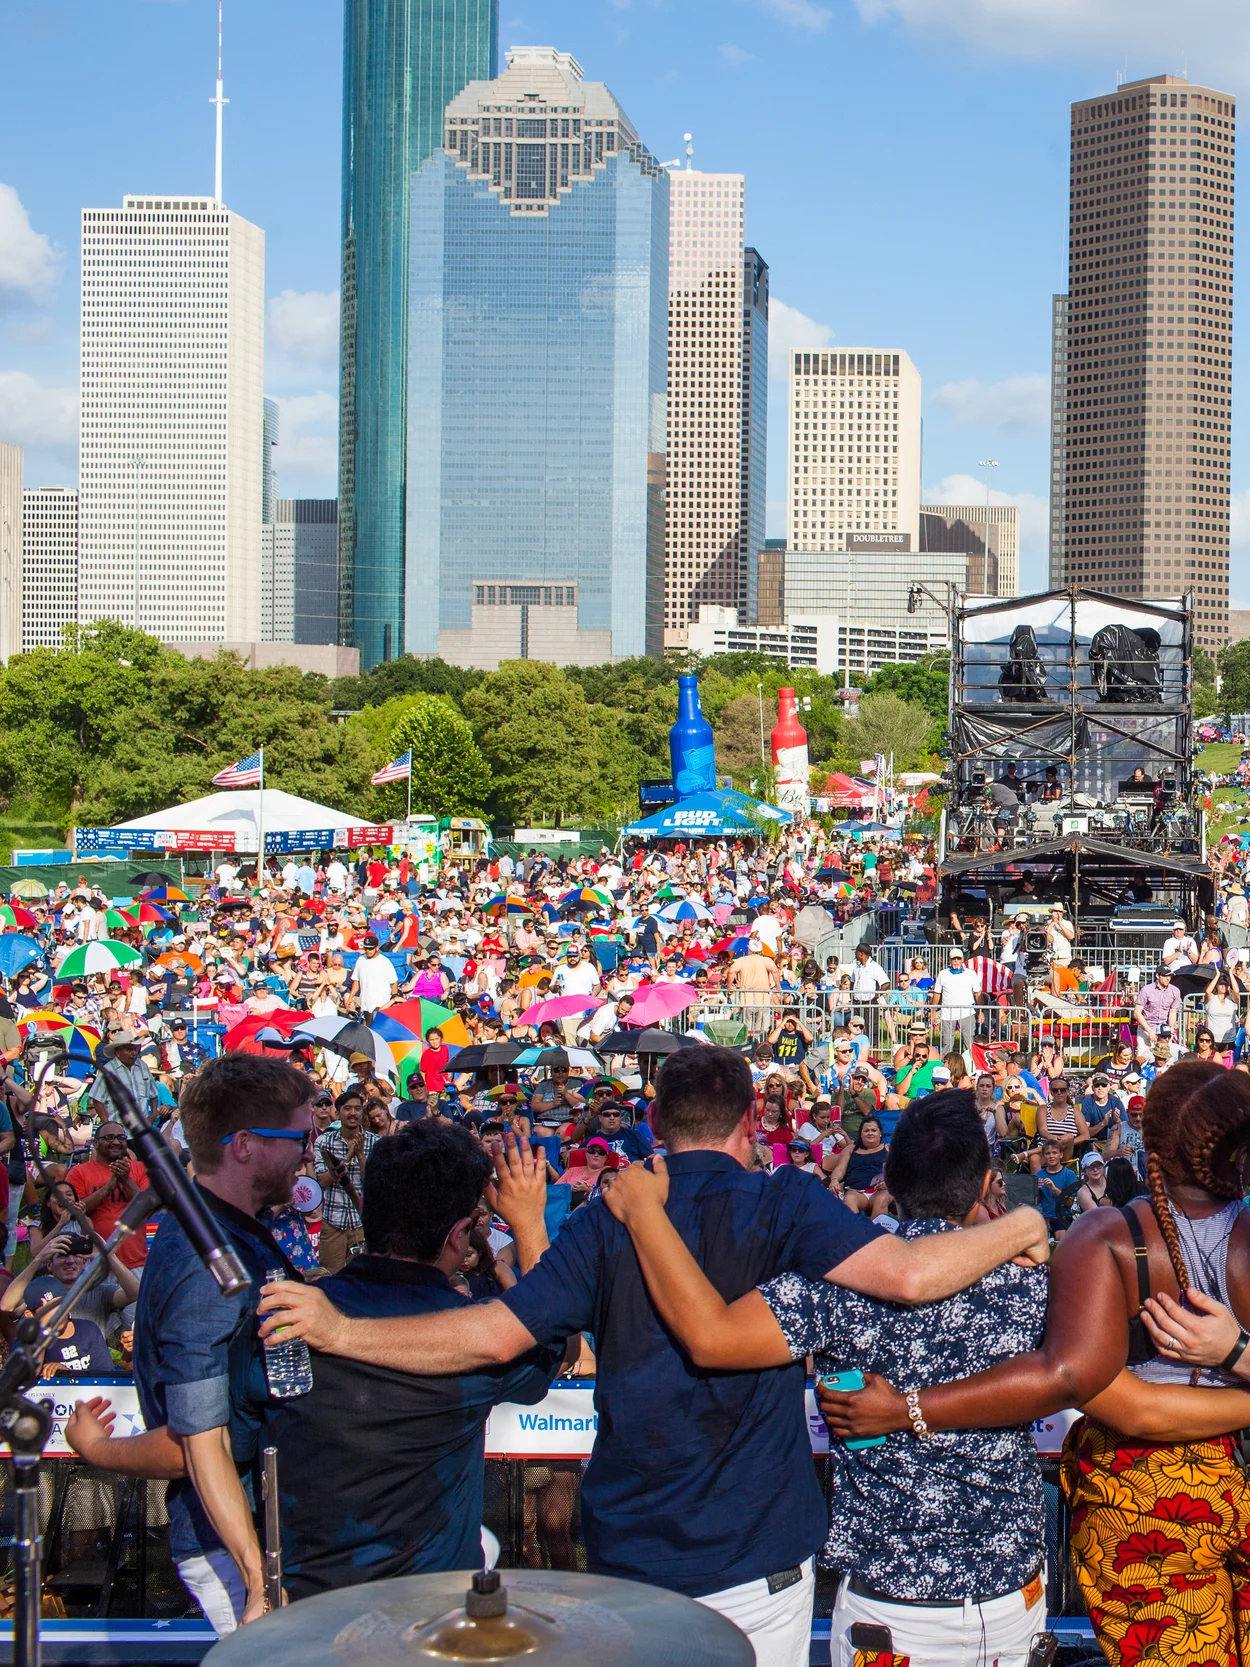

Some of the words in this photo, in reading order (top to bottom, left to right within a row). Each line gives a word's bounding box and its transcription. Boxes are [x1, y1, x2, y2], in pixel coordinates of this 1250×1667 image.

[853, 535, 904, 543] DOUBLETREE
[674, 810, 717, 819] BUD
[663, 818, 722, 827] LIGHT
[781, 1036, 798, 1046] VAULT
[778, 1045, 798, 1057] 111
[61, 1345, 79, 1360] 82
[519, 1414, 599, 1431] Walmart
